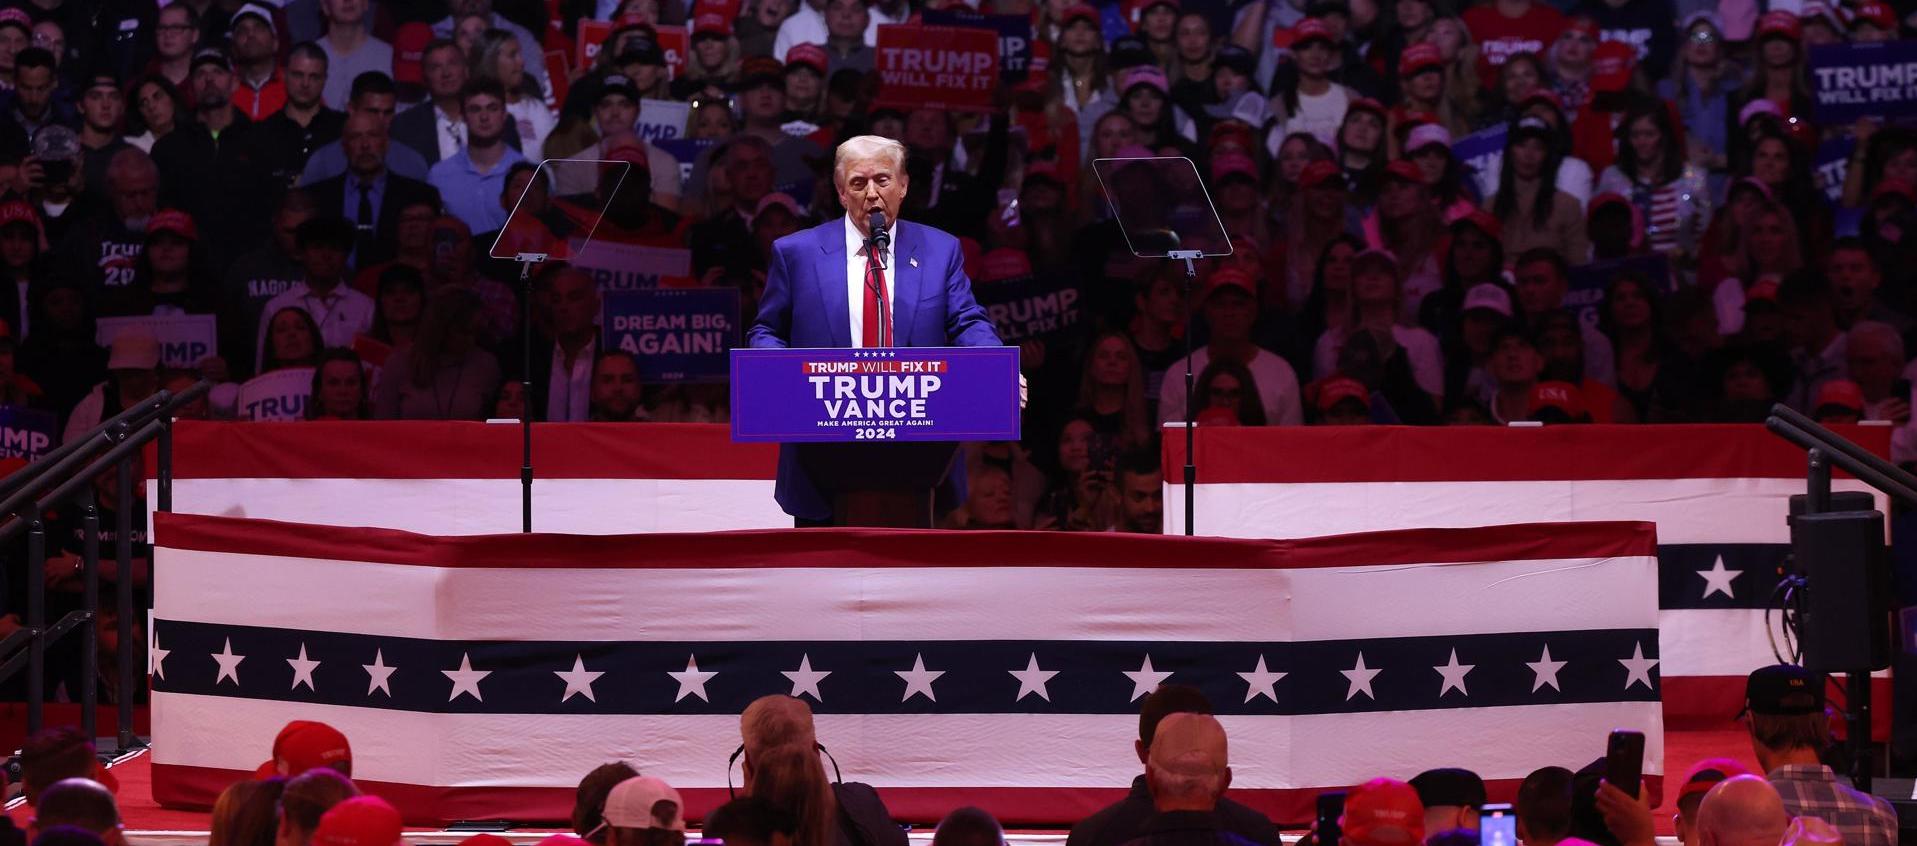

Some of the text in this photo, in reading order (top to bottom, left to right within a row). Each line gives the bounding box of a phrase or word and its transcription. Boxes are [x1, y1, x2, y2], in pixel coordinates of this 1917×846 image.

[880, 47, 993, 74] TRUMP
[880, 70, 992, 90] WILL FIX IT
[1817, 89, 1868, 106] WILL
[1870, 87, 1903, 103] FIX
[987, 288, 1080, 326] RUMP
[612, 312, 733, 332] DREAM BIG,
[618, 330, 724, 356] AGAIN!
[808, 361, 941, 373] TRUMP WILL FIX IT
[808, 375, 942, 399] TRUMP
[823, 399, 927, 419] VANCE
[906, 419, 934, 427] AGAIN!
[855, 427, 896, 440] 2024
